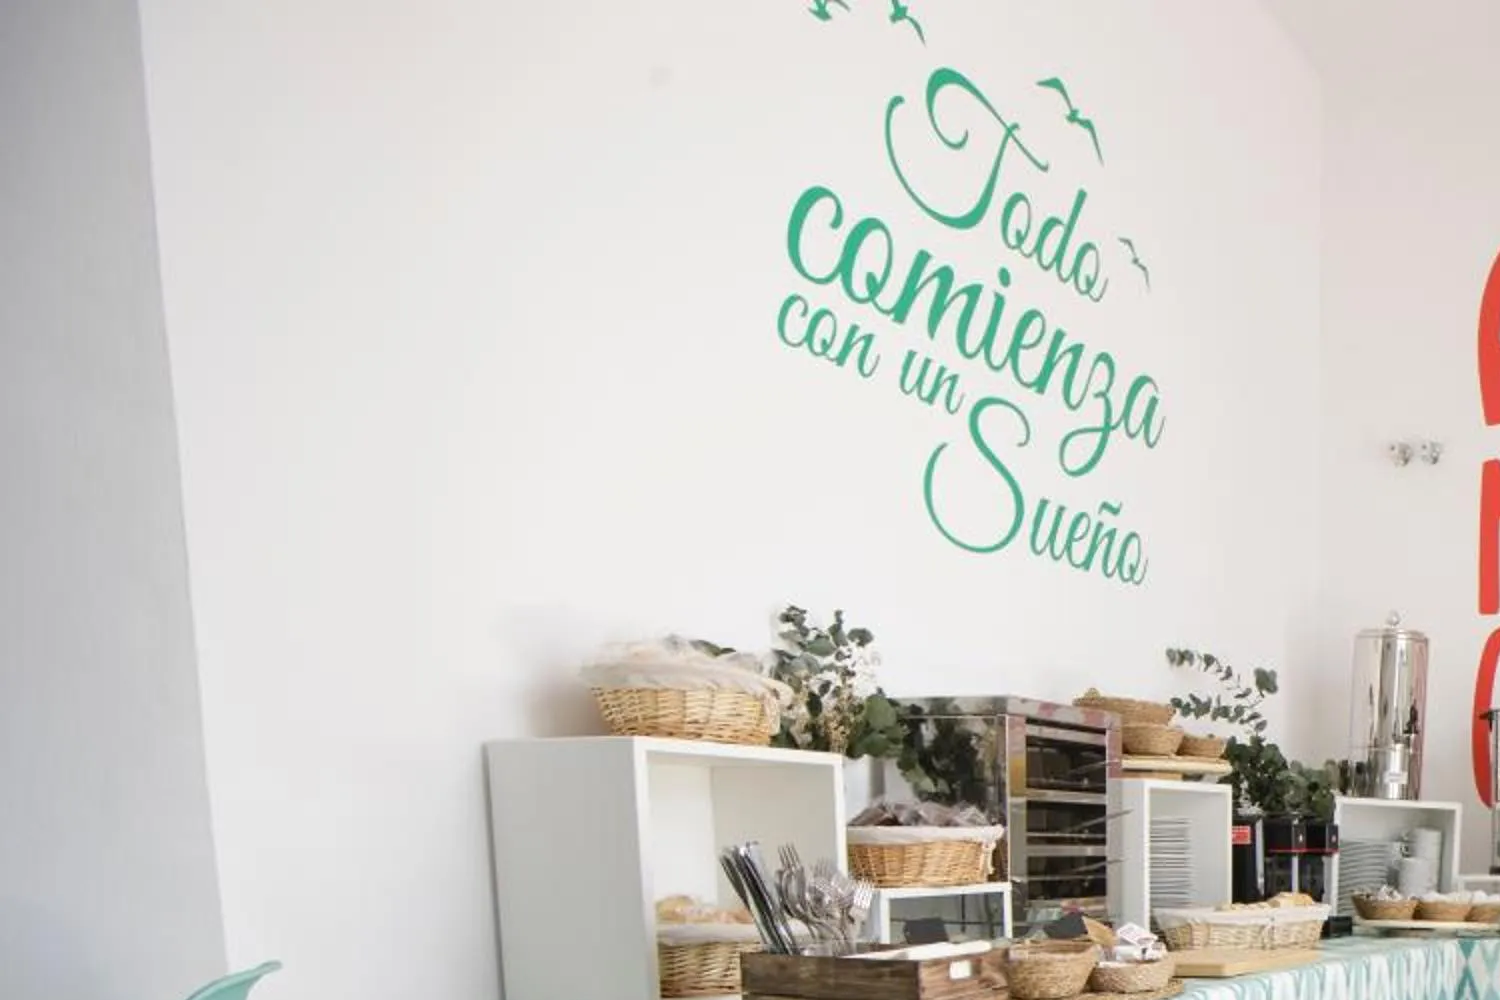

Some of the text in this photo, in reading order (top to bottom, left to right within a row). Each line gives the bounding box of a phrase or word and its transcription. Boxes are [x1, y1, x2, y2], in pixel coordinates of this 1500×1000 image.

[885, 67, 1108, 302] Todo
[776, 292, 965, 415] con un
[786, 184, 1165, 478] comienza
[922, 396, 1149, 586] Sueño
